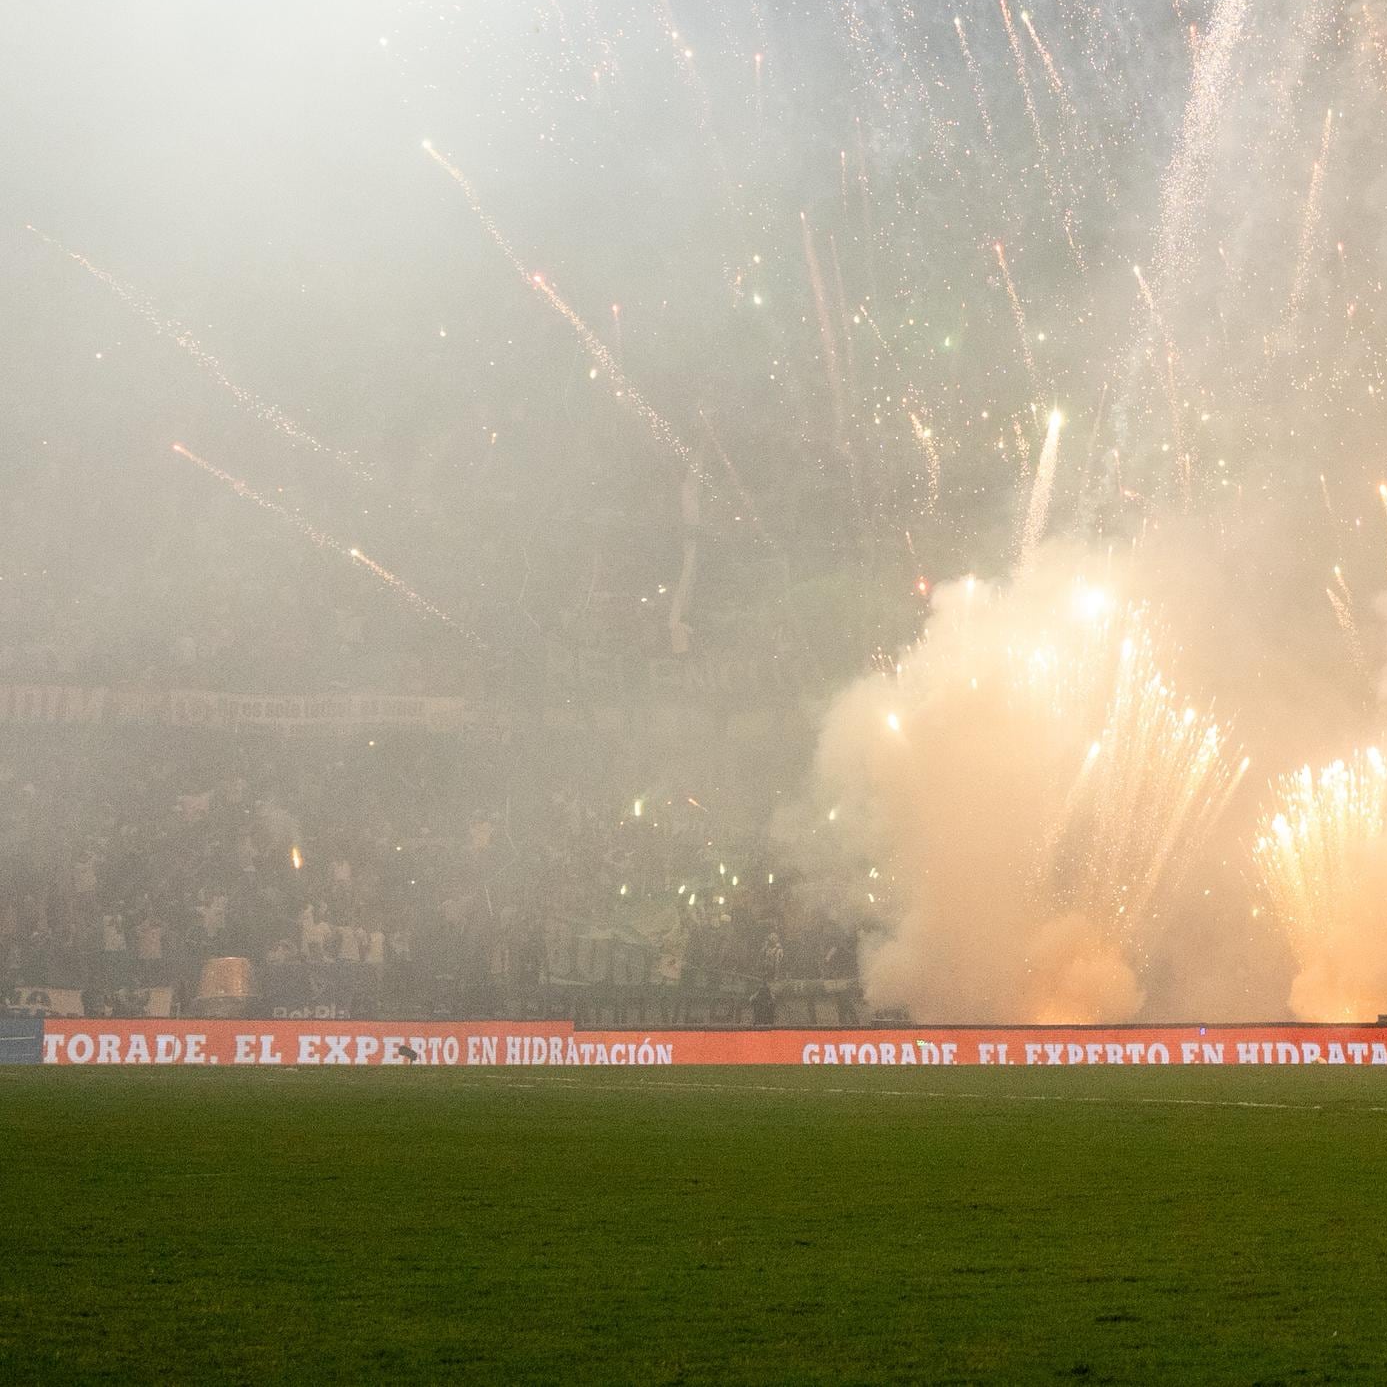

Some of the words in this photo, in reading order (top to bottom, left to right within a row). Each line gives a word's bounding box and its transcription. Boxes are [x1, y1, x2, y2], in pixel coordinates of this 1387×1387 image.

[235, 1034, 281, 1064] EL
[297, 1035, 459, 1064] EXPERTO
[467, 1037, 498, 1064] EN
[506, 1036, 673, 1065] HIDRATACIÓN
[1025, 1043, 1170, 1065] EXPERTO
[1181, 1043, 1224, 1065] EN
